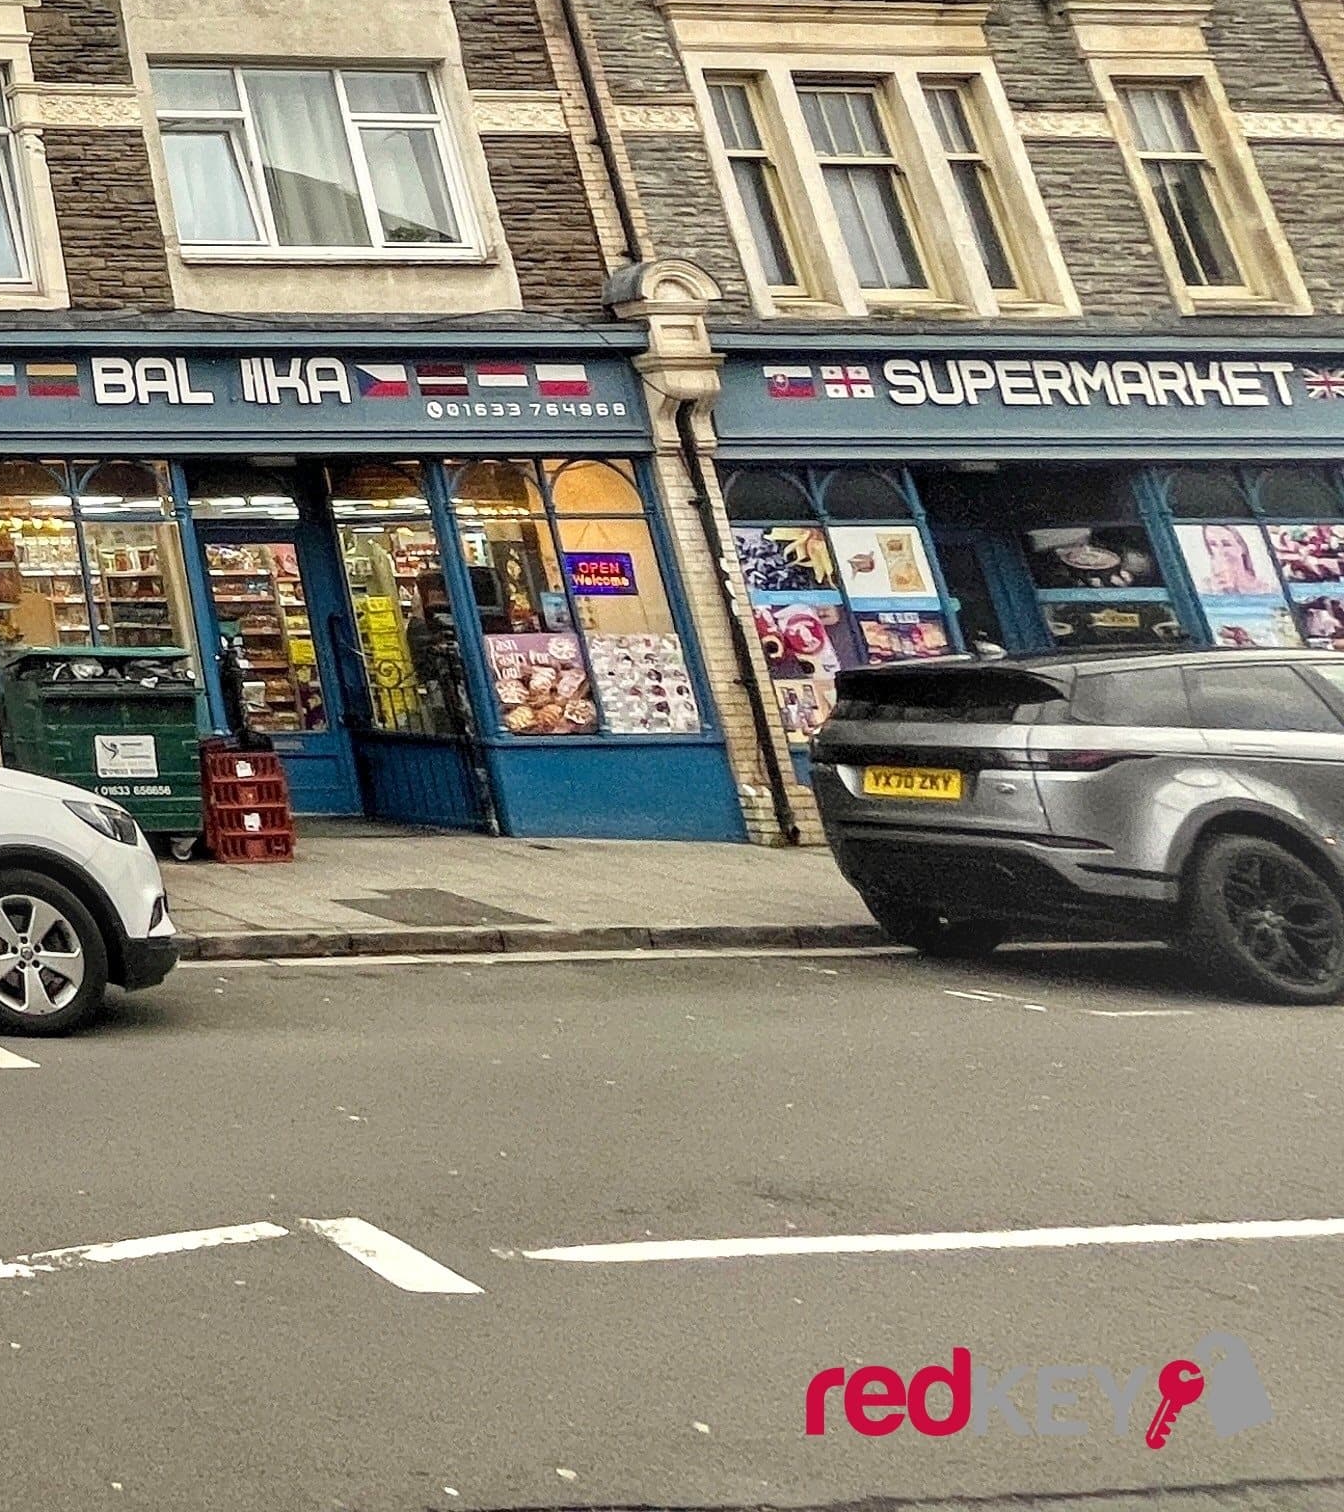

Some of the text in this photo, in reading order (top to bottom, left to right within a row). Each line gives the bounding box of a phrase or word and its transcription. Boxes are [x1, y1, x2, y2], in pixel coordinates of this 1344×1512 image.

[91, 357, 215, 404] BAL
[883, 359, 1295, 407] SUPERMARKET
[446, 403, 626, 417] 01633 764968
[578, 562, 620, 573] OPEN
[572, 575, 629, 587] Welcome
